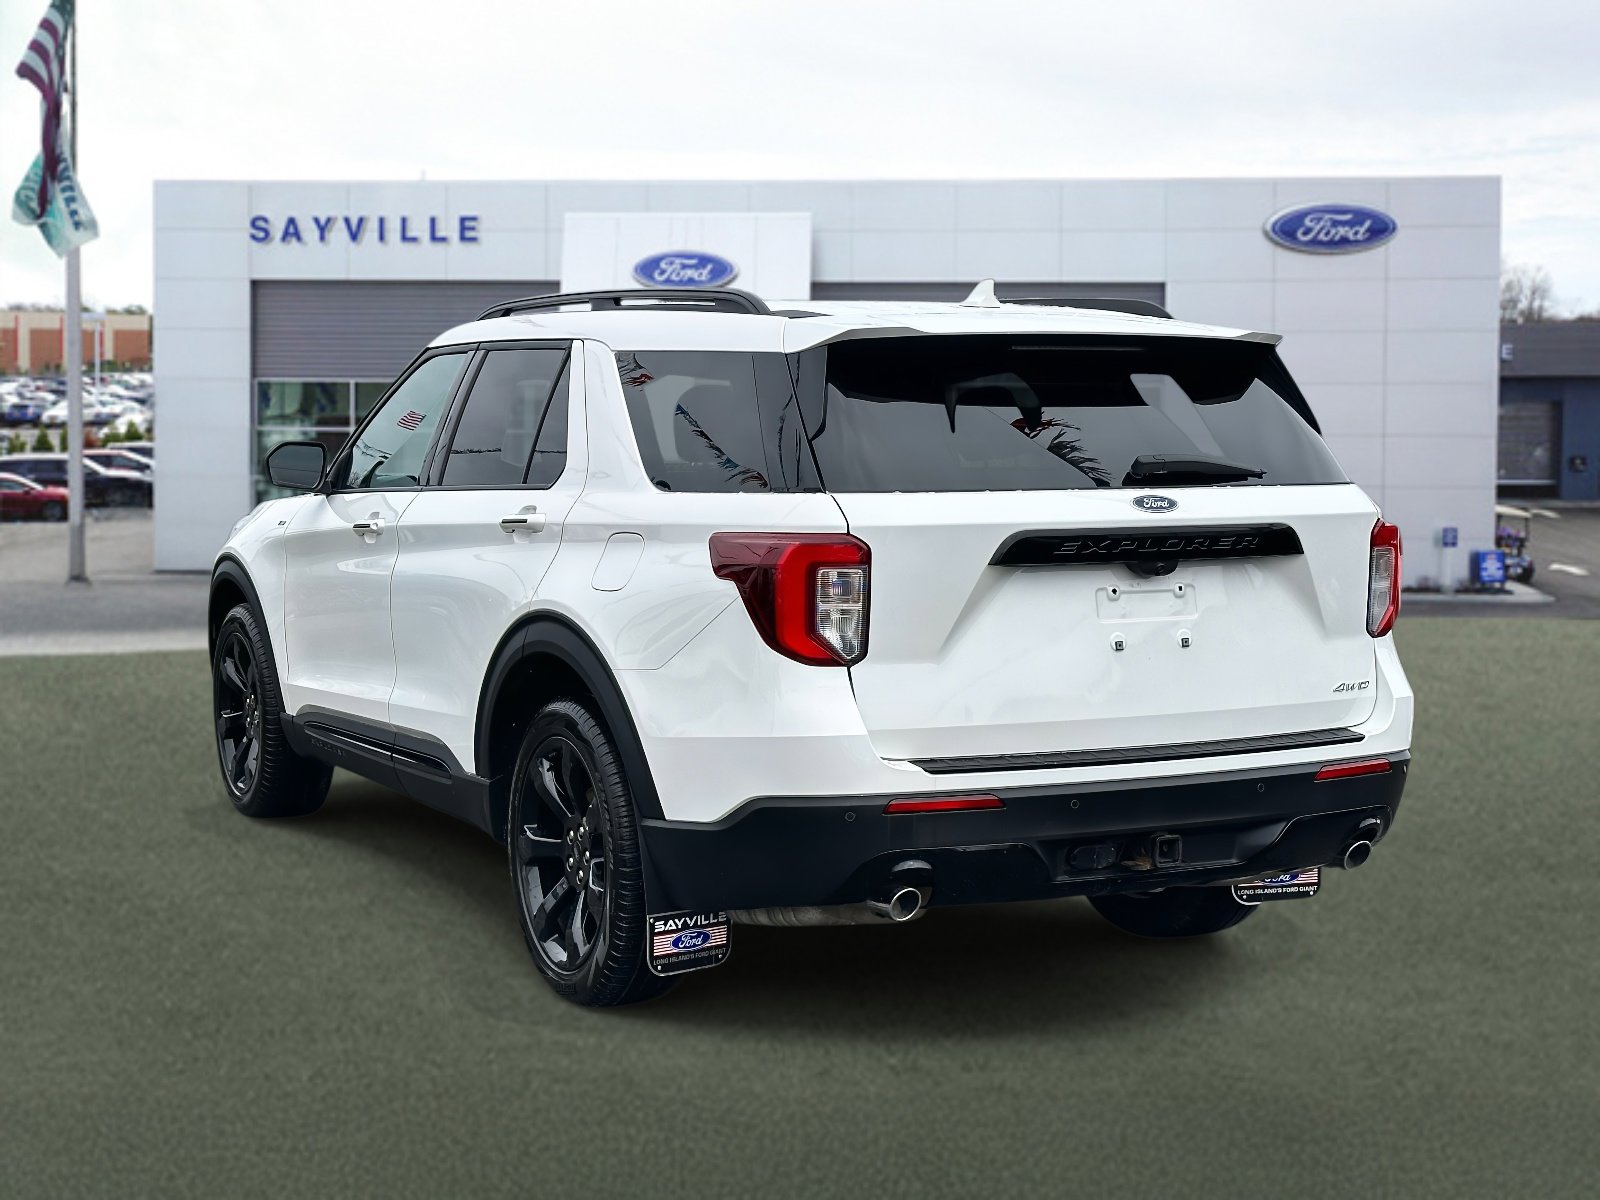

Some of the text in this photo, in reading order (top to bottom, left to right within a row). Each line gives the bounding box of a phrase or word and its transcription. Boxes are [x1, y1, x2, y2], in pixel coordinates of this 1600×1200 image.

[249, 214, 480, 244] SAYVILLE
[1296, 213, 1373, 242] Ford
[653, 256, 713, 281] Ford
[1143, 497, 1170, 508] Ford
[1053, 537, 1260, 555] EXPLORER
[1333, 680, 1370, 693] 4WD
[1237, 888, 1255, 896] LONG
[654, 912, 727, 933] SAYVILLE
[678, 932, 704, 948] Ford
[653, 957, 669, 966] LONG
